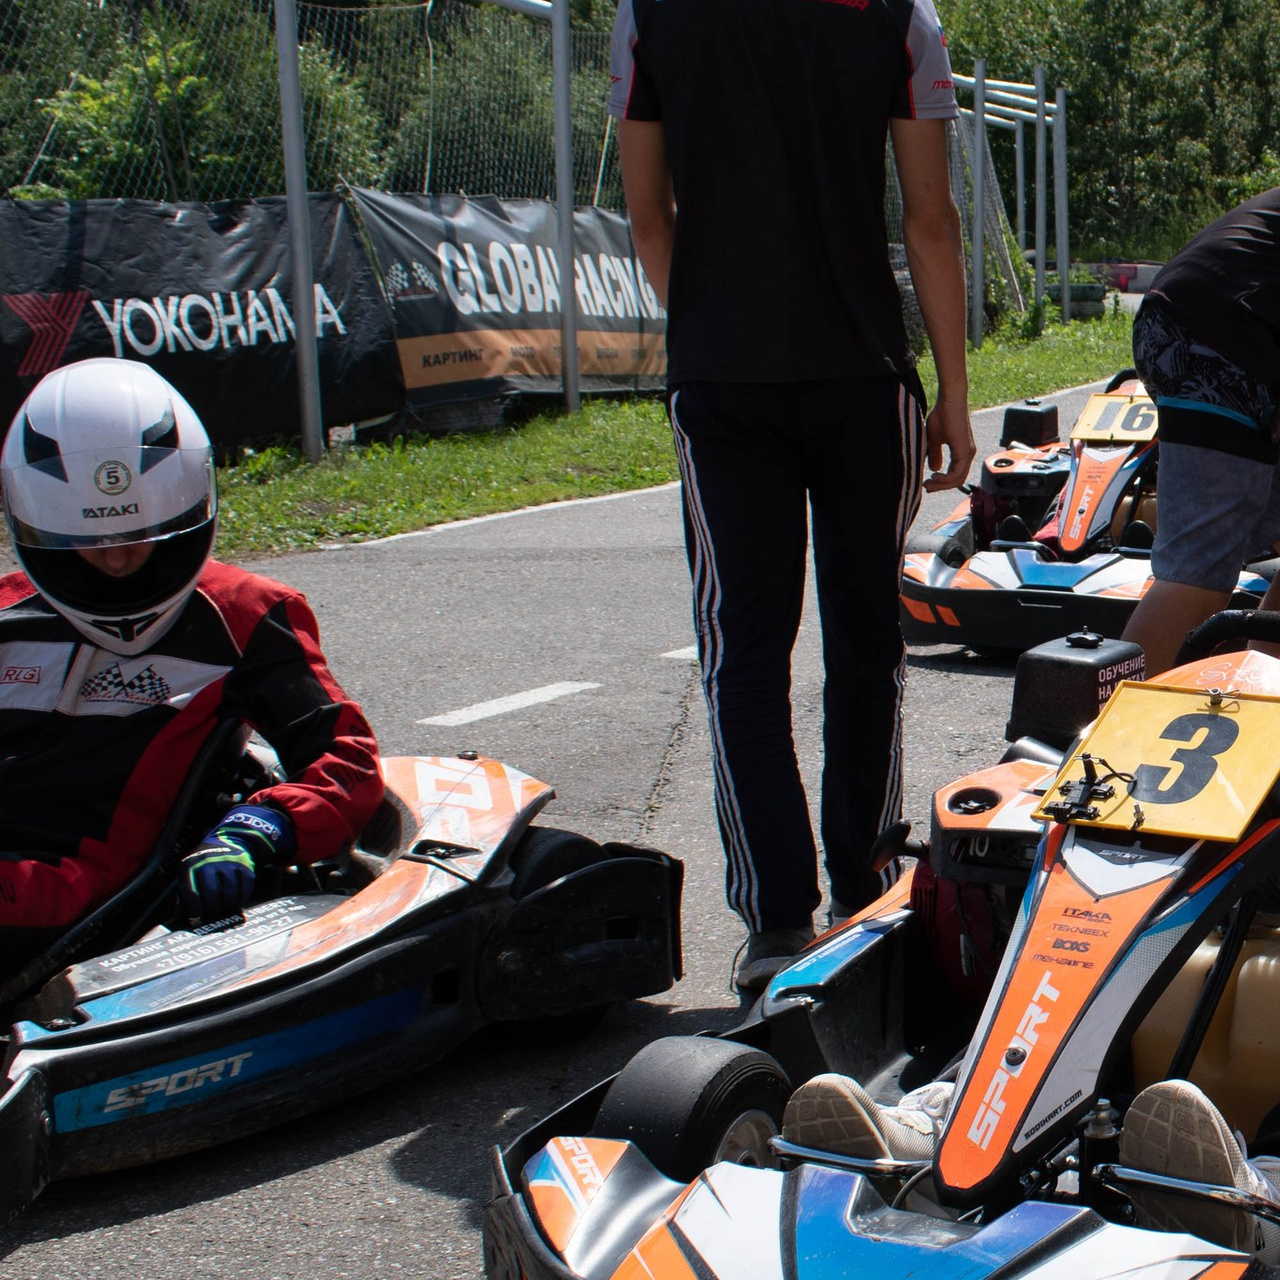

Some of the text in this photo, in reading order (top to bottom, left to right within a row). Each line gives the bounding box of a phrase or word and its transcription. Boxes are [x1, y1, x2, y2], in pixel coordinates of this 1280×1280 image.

[436, 240, 563, 316] GLOBA
[421, 347, 485, 368] КАРТИНГ
[1092, 401, 1158, 432] 16
[106, 470, 120, 486] 5
[82, 503, 139, 519] ATAKI
[1098, 653, 1146, 683] ОБУЧЕНИЕ
[1098, 684, 1112, 701] НА
[1127, 712, 1240, 805] 3
[1099, 848, 1149, 861] SPORT
[1062, 906, 1113, 921] ITAKA
[99, 940, 164, 968] КАРТИНГ
[166, 915, 243, 948] АКАДЕМИЯ
[214, 915, 294, 951] 561-90-27
[1051, 923, 1110, 938] TEKNEEX
[966, 970, 1061, 1151] SPORT
[103, 1051, 254, 1114] SPORT
